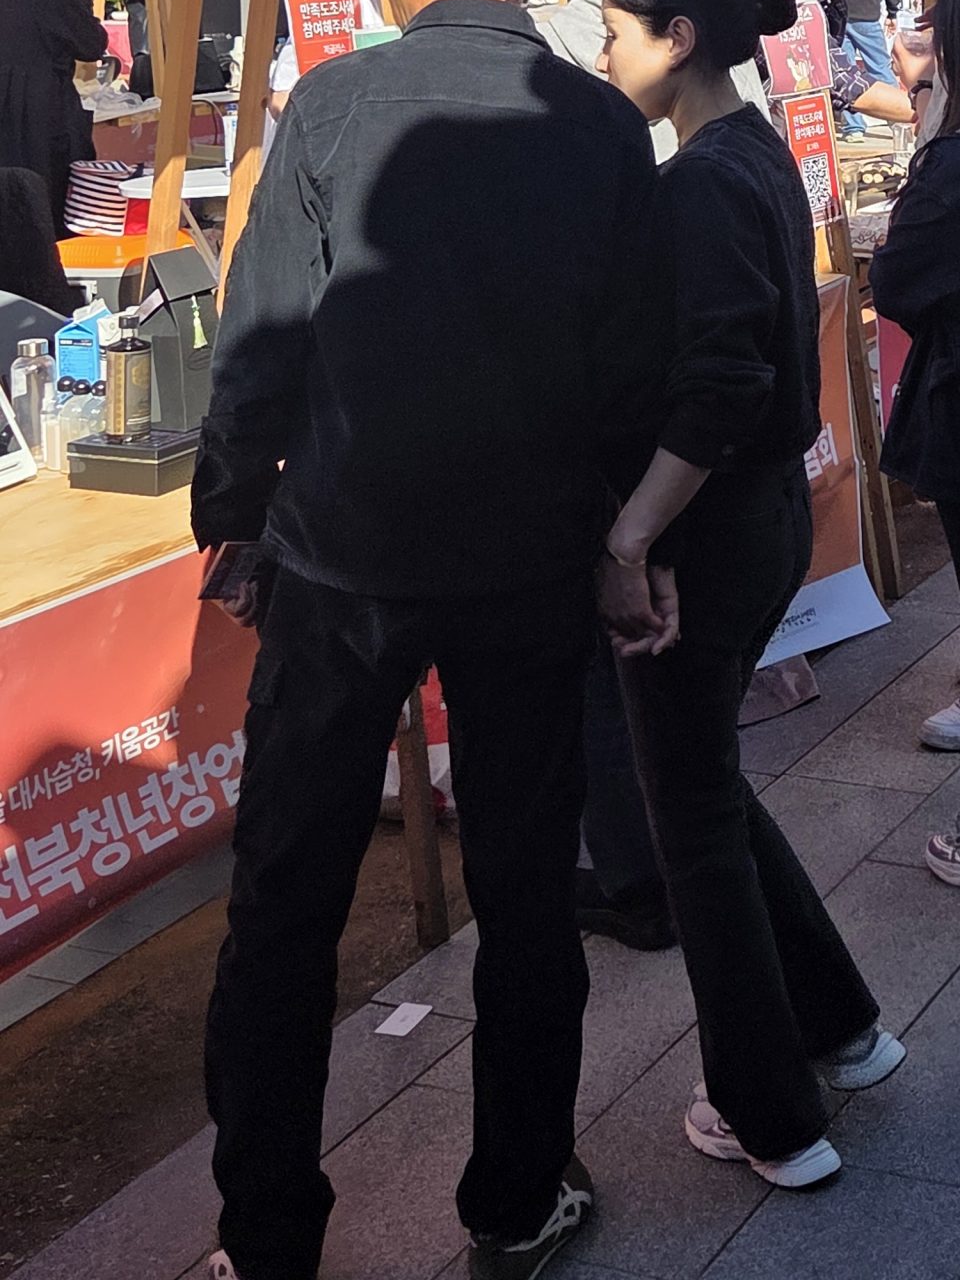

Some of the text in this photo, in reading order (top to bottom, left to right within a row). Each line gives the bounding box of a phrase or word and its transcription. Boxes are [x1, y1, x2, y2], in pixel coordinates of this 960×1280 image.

[300, 0, 355, 19] 만족도조사에
[303, 17, 356, 39] 참여해주세요
[9, 747, 101, 812] 대사습청,
[100, 706, 180, 766] 키움공간
